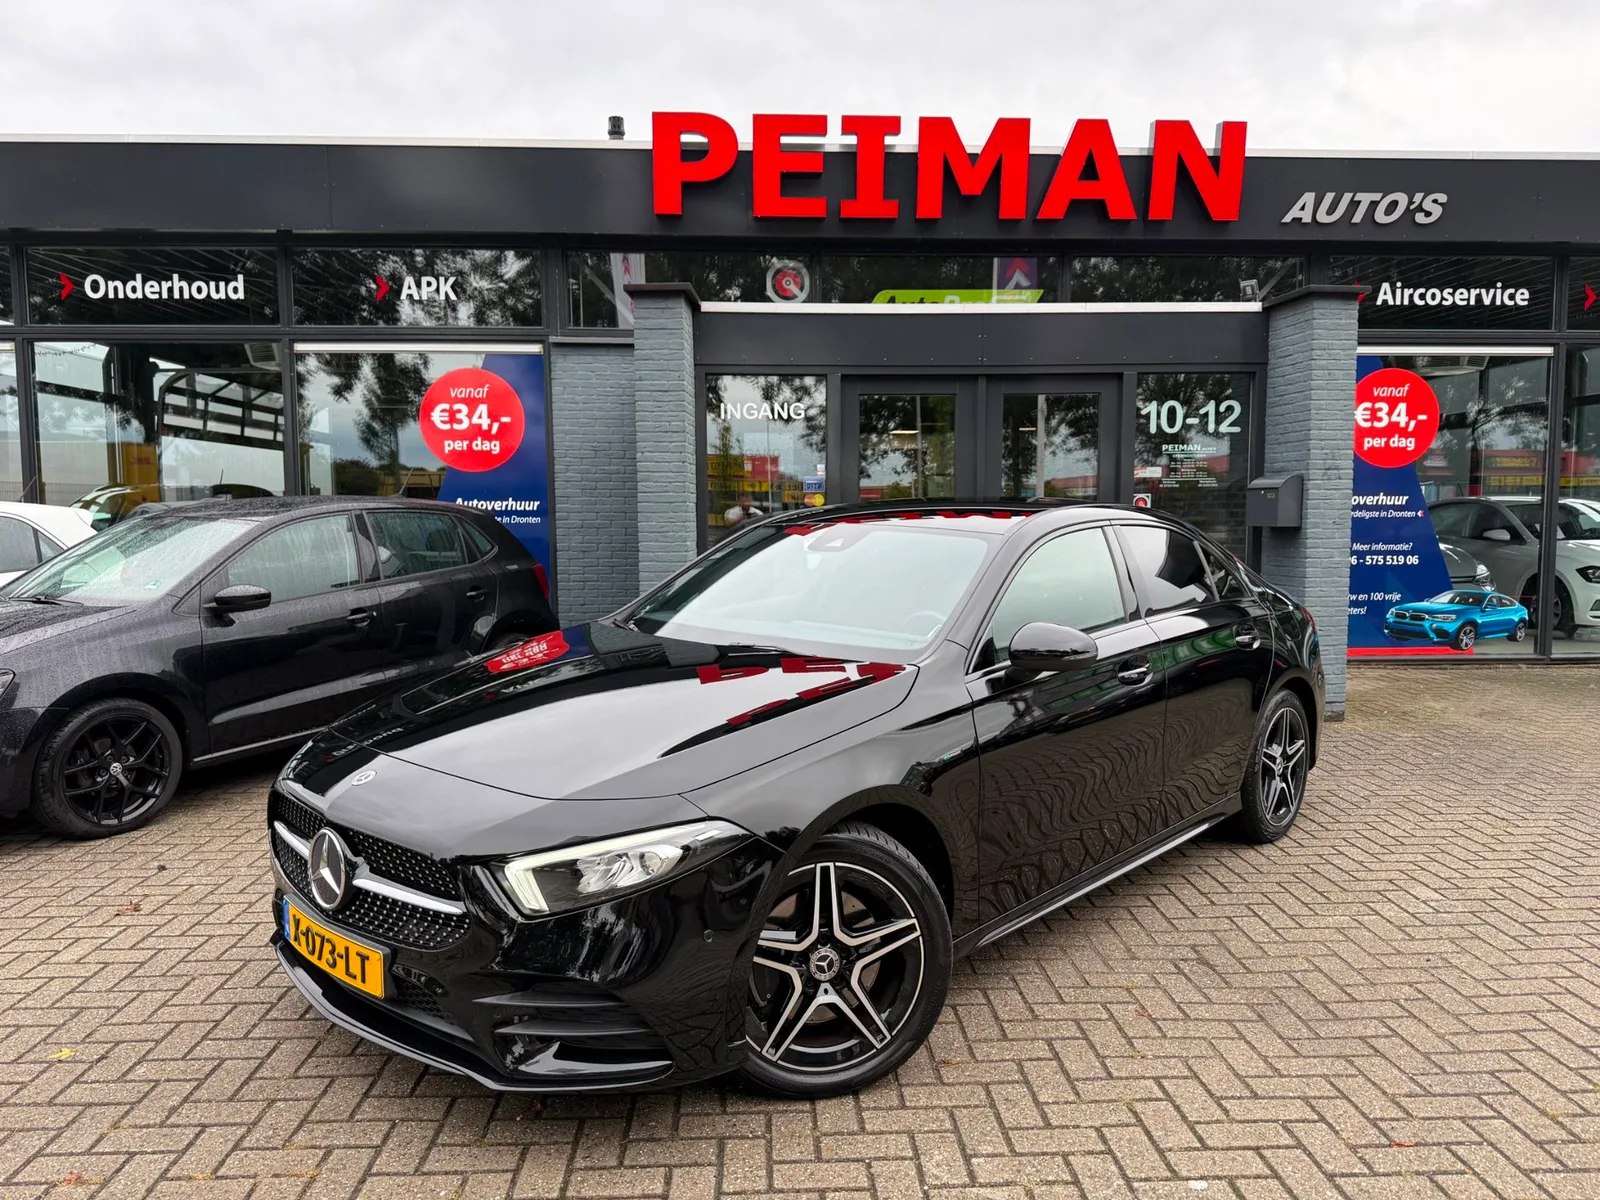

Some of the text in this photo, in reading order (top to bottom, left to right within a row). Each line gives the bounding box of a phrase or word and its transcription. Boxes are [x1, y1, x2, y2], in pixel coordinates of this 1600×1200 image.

[651, 111, 1248, 221] PEIMAN
[1281, 191, 1448, 225] AUTO'S
[84, 272, 245, 300] Onderhoud
[400, 276, 457, 301] APK
[1376, 282, 1530, 307] Aircoservice
[450, 384, 490, 398] vanaf
[1373, 383, 1410, 397] vanaf
[430, 403, 511, 435] €34,-
[720, 402, 805, 420] INGANG
[1140, 399, 1242, 435] 10-12
[1353, 401, 1428, 432] €34,-
[444, 436, 500, 454] per dag
[1364, 434, 1415, 451] per dag
[1351, 492, 1409, 505] overhuur
[502, 515, 510, 523] in
[511, 515, 541, 524] Dronten
[1351, 509, 1416, 519] rdeligste in Dronten
[1352, 542, 1413, 551] Meer informatie?
[1349, 555, 1357, 565] 6
[1365, 555, 1384, 565] 575
[1385, 555, 1405, 565] 519
[1406, 555, 1419, 565] 06
[1358, 593, 1367, 601] en
[1370, 592, 1384, 601] 100
[1385, 592, 1401, 602] vrije
[1347, 606, 1367, 615] eters!
[292, 914, 369, 984] X-073-LT
